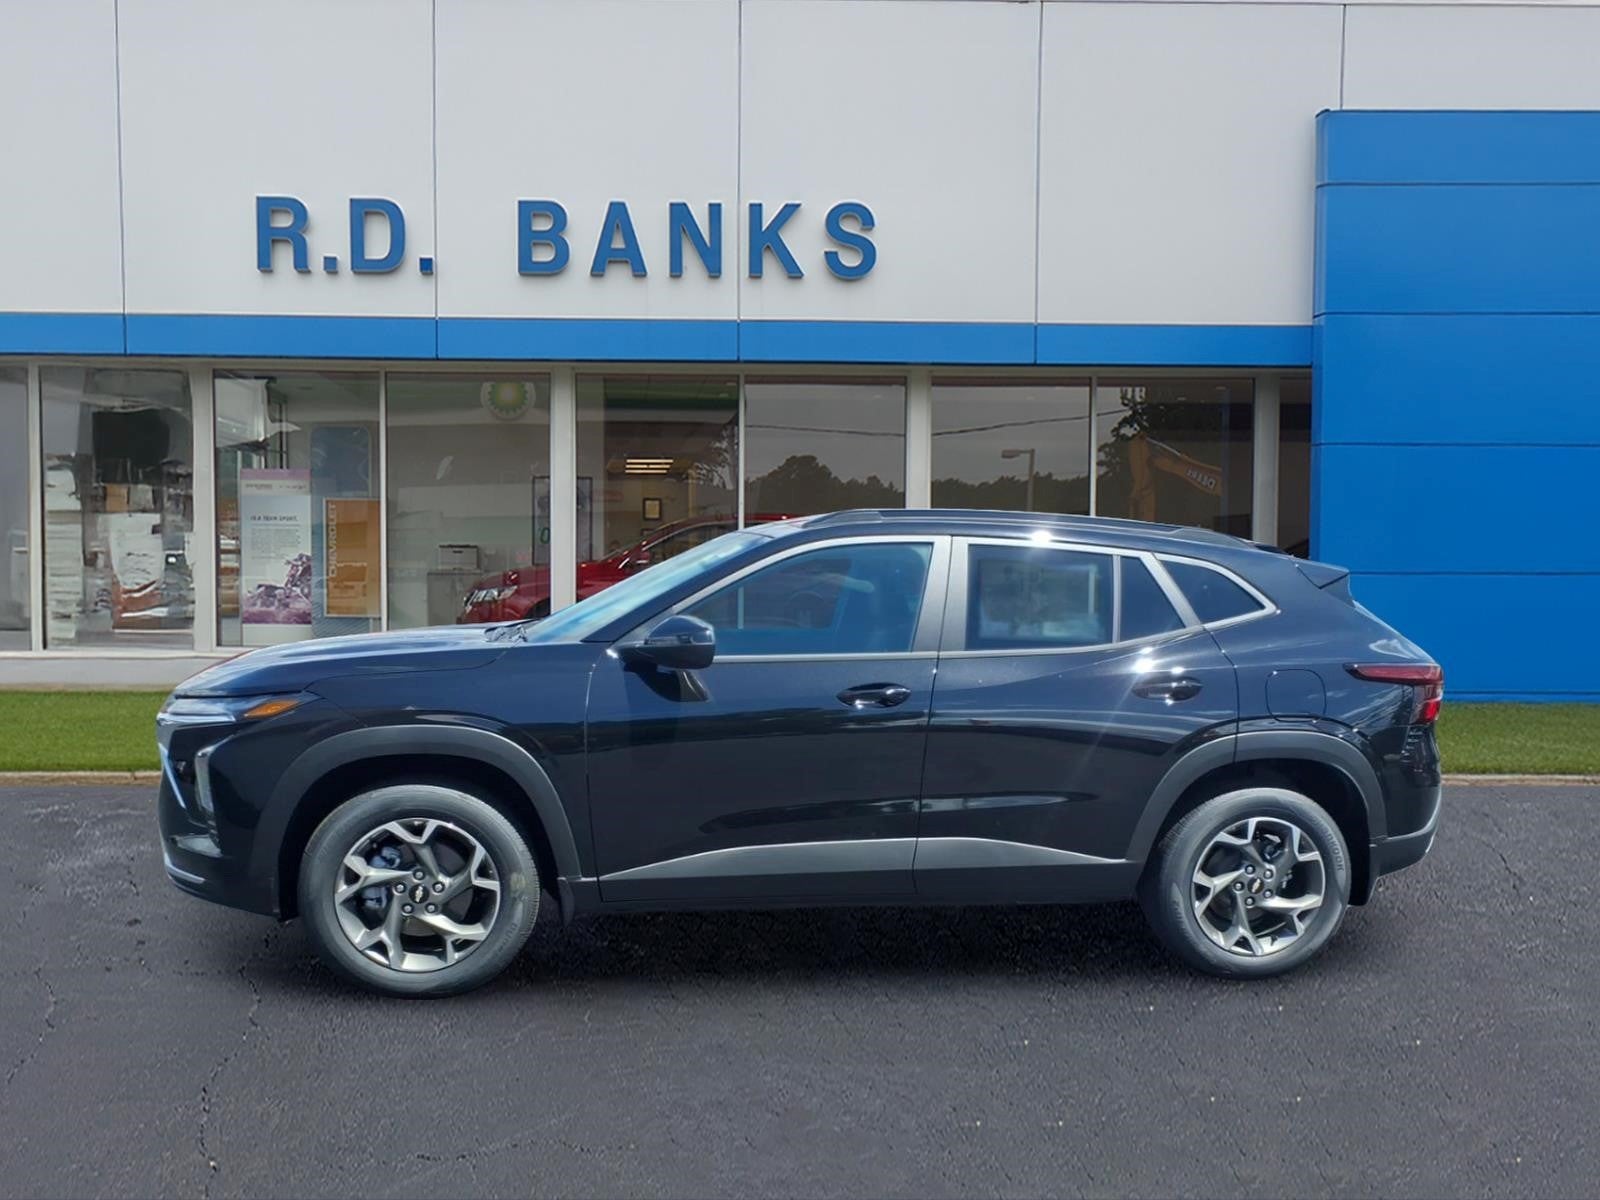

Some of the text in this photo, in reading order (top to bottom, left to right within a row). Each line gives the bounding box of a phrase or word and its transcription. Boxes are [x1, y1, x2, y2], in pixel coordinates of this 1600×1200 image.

[256, 195, 878, 282] R.D. BANKS
[328, 502, 337, 577] CHEVROLET
